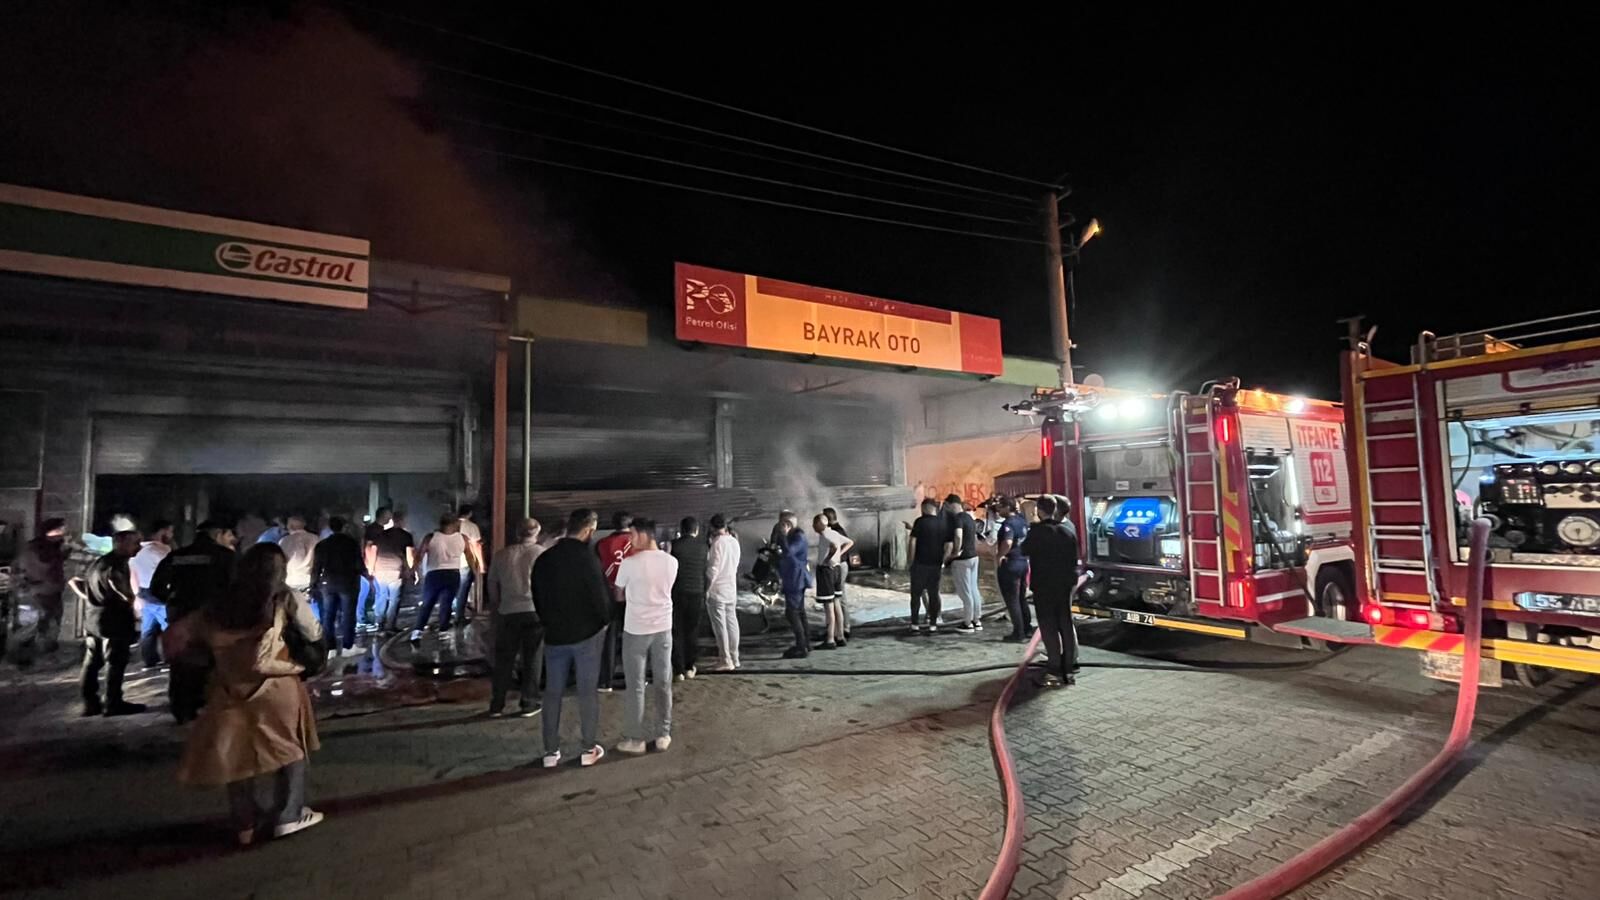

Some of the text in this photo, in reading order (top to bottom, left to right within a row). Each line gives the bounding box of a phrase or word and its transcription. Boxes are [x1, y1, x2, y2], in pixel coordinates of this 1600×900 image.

[254, 249, 355, 283] Castrol
[685, 316, 737, 331] Petrol Ofisi
[803, 321, 921, 354] BAYRAK OTO
[1312, 458, 1333, 482] 112
